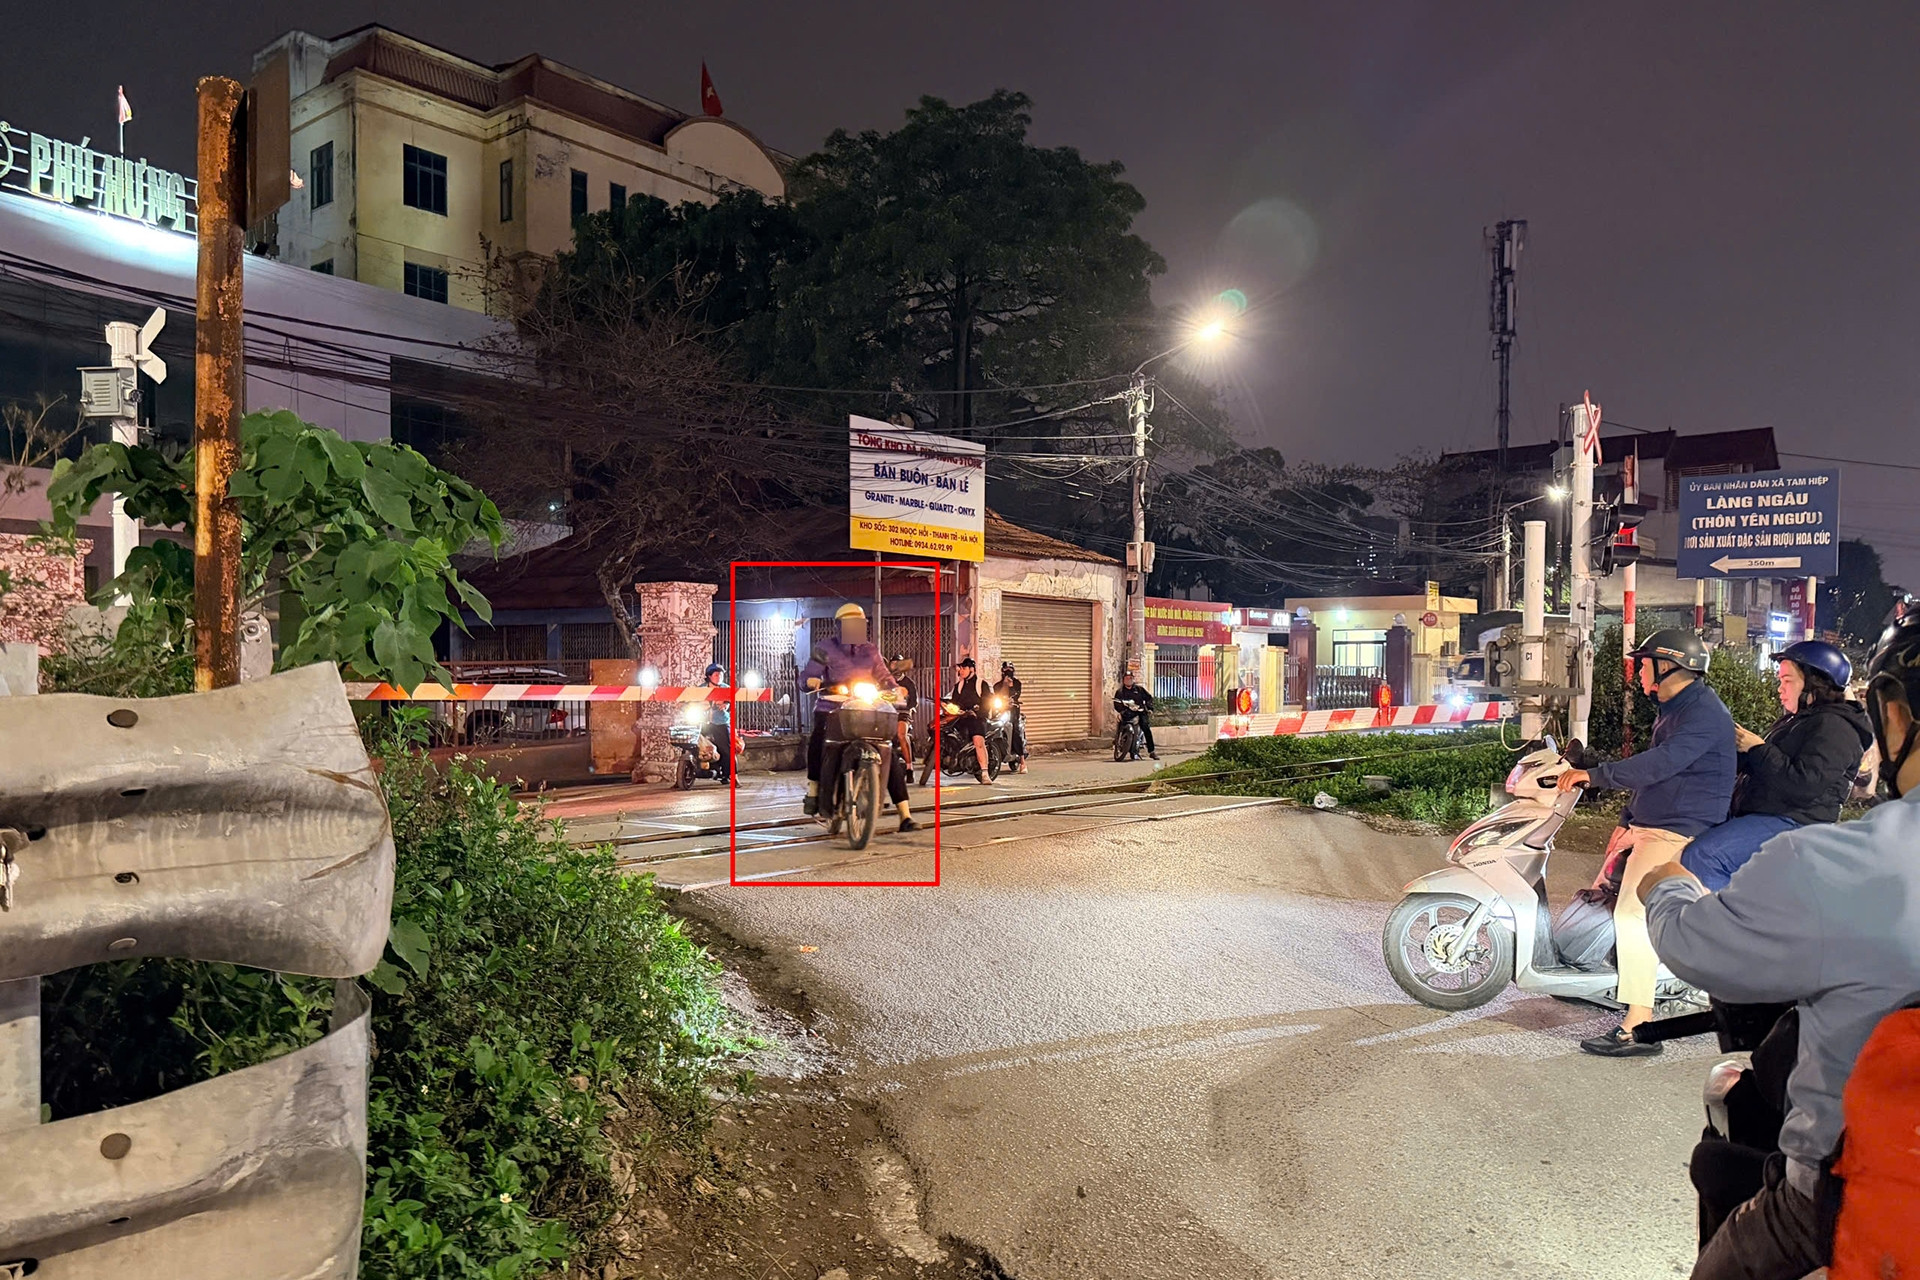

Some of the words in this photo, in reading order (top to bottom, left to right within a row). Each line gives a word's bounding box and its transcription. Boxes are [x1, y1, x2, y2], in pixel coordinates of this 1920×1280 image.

[30, 132, 93, 203] PHÚ
[104, 154, 186, 231] HƯNG
[884, 439, 903, 452] KHO
[874, 461, 896, 480] BÁN
[900, 468, 928, 486] BUÔN
[936, 473, 956, 491] BÁN
[959, 476, 969, 493] LẺ
[1703, 483, 1721, 491] BAN
[1723, 480, 1748, 490] NHÂN
[1750, 479, 1770, 489] DÂN
[1771, 478, 1785, 487] XÃ
[1787, 478, 1807, 487] TAM
[1808, 475, 1829, 486] HIỆP
[864, 490, 894, 505] GRANITE
[899, 497, 925, 509] MARBLE
[930, 502, 953, 514] QUARTZ
[958, 506, 976, 517] ONYX
[1706, 495, 1753, 510] LÀNG
[1757, 491, 1809, 508] NGÂU
[859, 521, 872, 530] KHO
[888, 525, 899, 534] 302
[1692, 514, 1736, 530] (THÔN
[1740, 512, 1770, 527] YÊN
[1772, 511, 1824, 526] NGƯU)
[1699, 532, 1715, 549] SẢN
[1716, 532, 1736, 548] XUẤT
[1737, 533, 1753, 549] ĐẶC
[1754, 530, 1772, 547] SẢN
[1796, 533, 1812, 546] HOA
[1813, 530, 1831, 546] CÚC
[1473, 859, 1497, 867] HONDA
